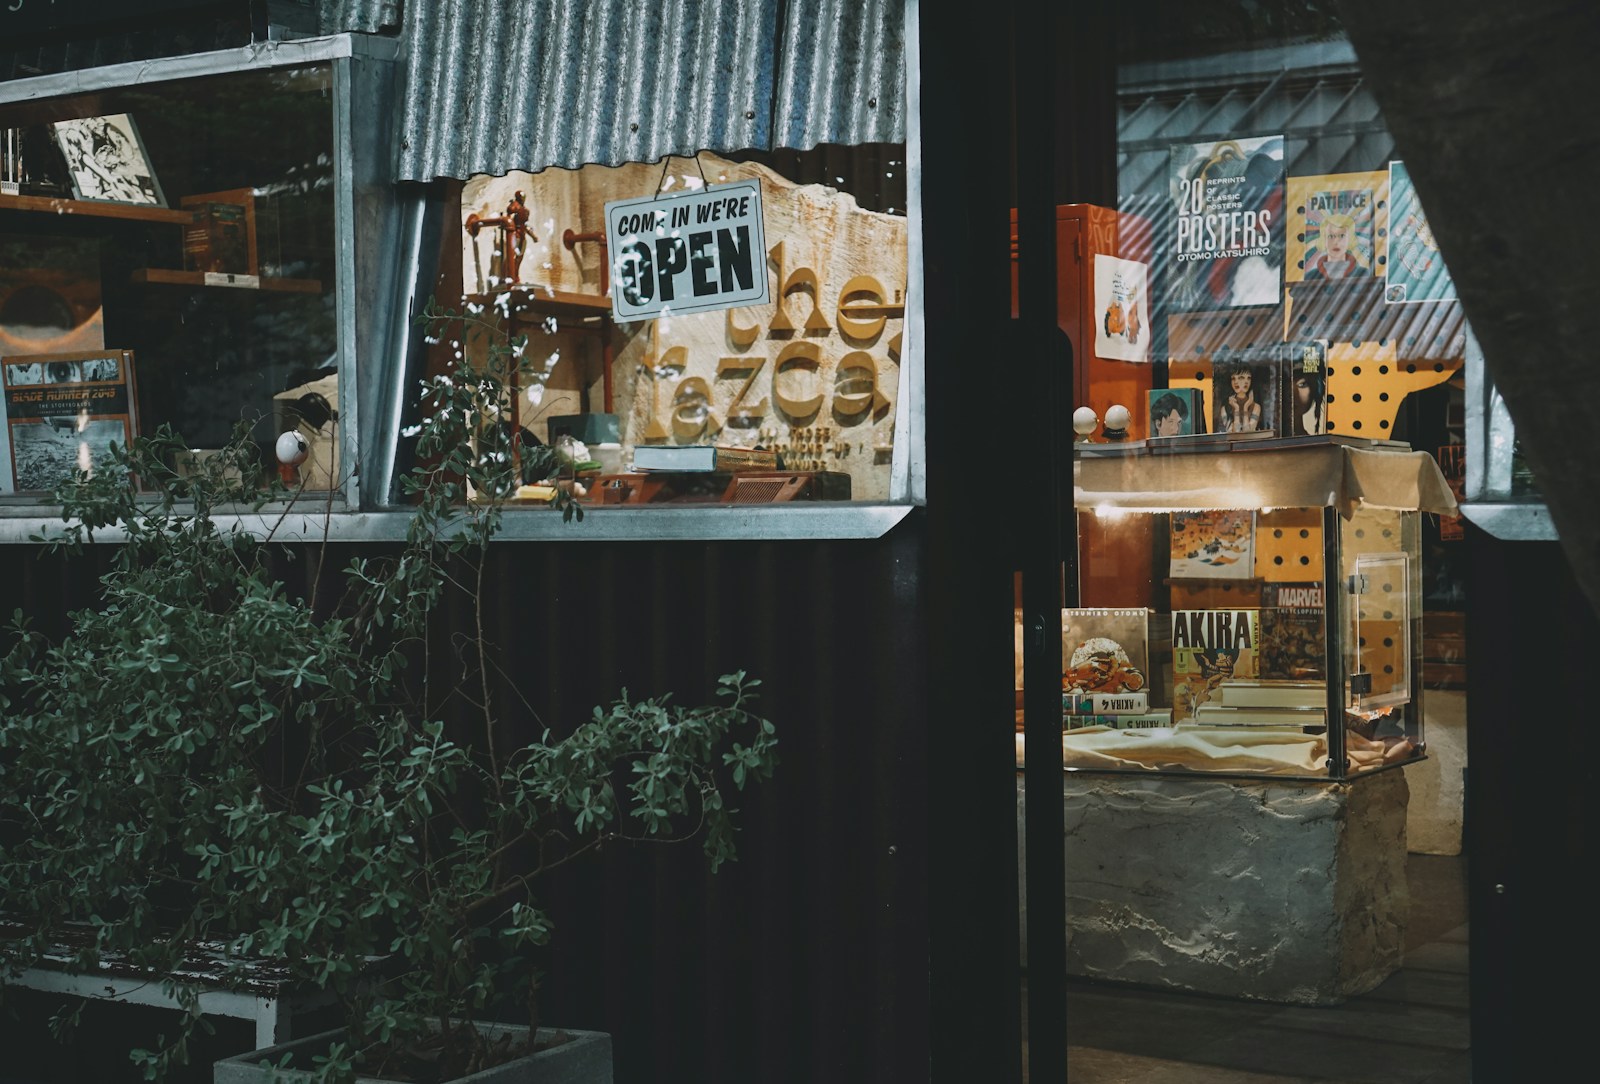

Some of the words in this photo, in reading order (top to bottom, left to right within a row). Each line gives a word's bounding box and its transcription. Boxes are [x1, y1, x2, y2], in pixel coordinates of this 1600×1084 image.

[1206, 176, 1246, 186] REPRINTS
[1179, 177, 1204, 216] 20
[1206, 193, 1241, 202] CLASSIC
[1310, 193, 1367, 211] PATIENCE
[671, 205, 690, 228] IN
[696, 196, 750, 224] WE'RE
[1206, 202, 1243, 211] POSTERS
[1177, 209, 1272, 254] POSTERS
[1177, 251, 1212, 262] OTOMO
[1213, 247, 1270, 259] KATSUHIRO
[621, 225, 754, 307] OPEN
[12, 390, 43, 403] BLADE
[47, 388, 90, 401] RUNNER
[92, 386, 117, 399] 2049
[1278, 587, 1324, 608] MARVEL
[1114, 609, 1145, 617] OTOMO
[1173, 611, 1252, 650] AKIRA
[1101, 699, 1110, 710] 4
[1111, 699, 1135, 710] AKIRA
